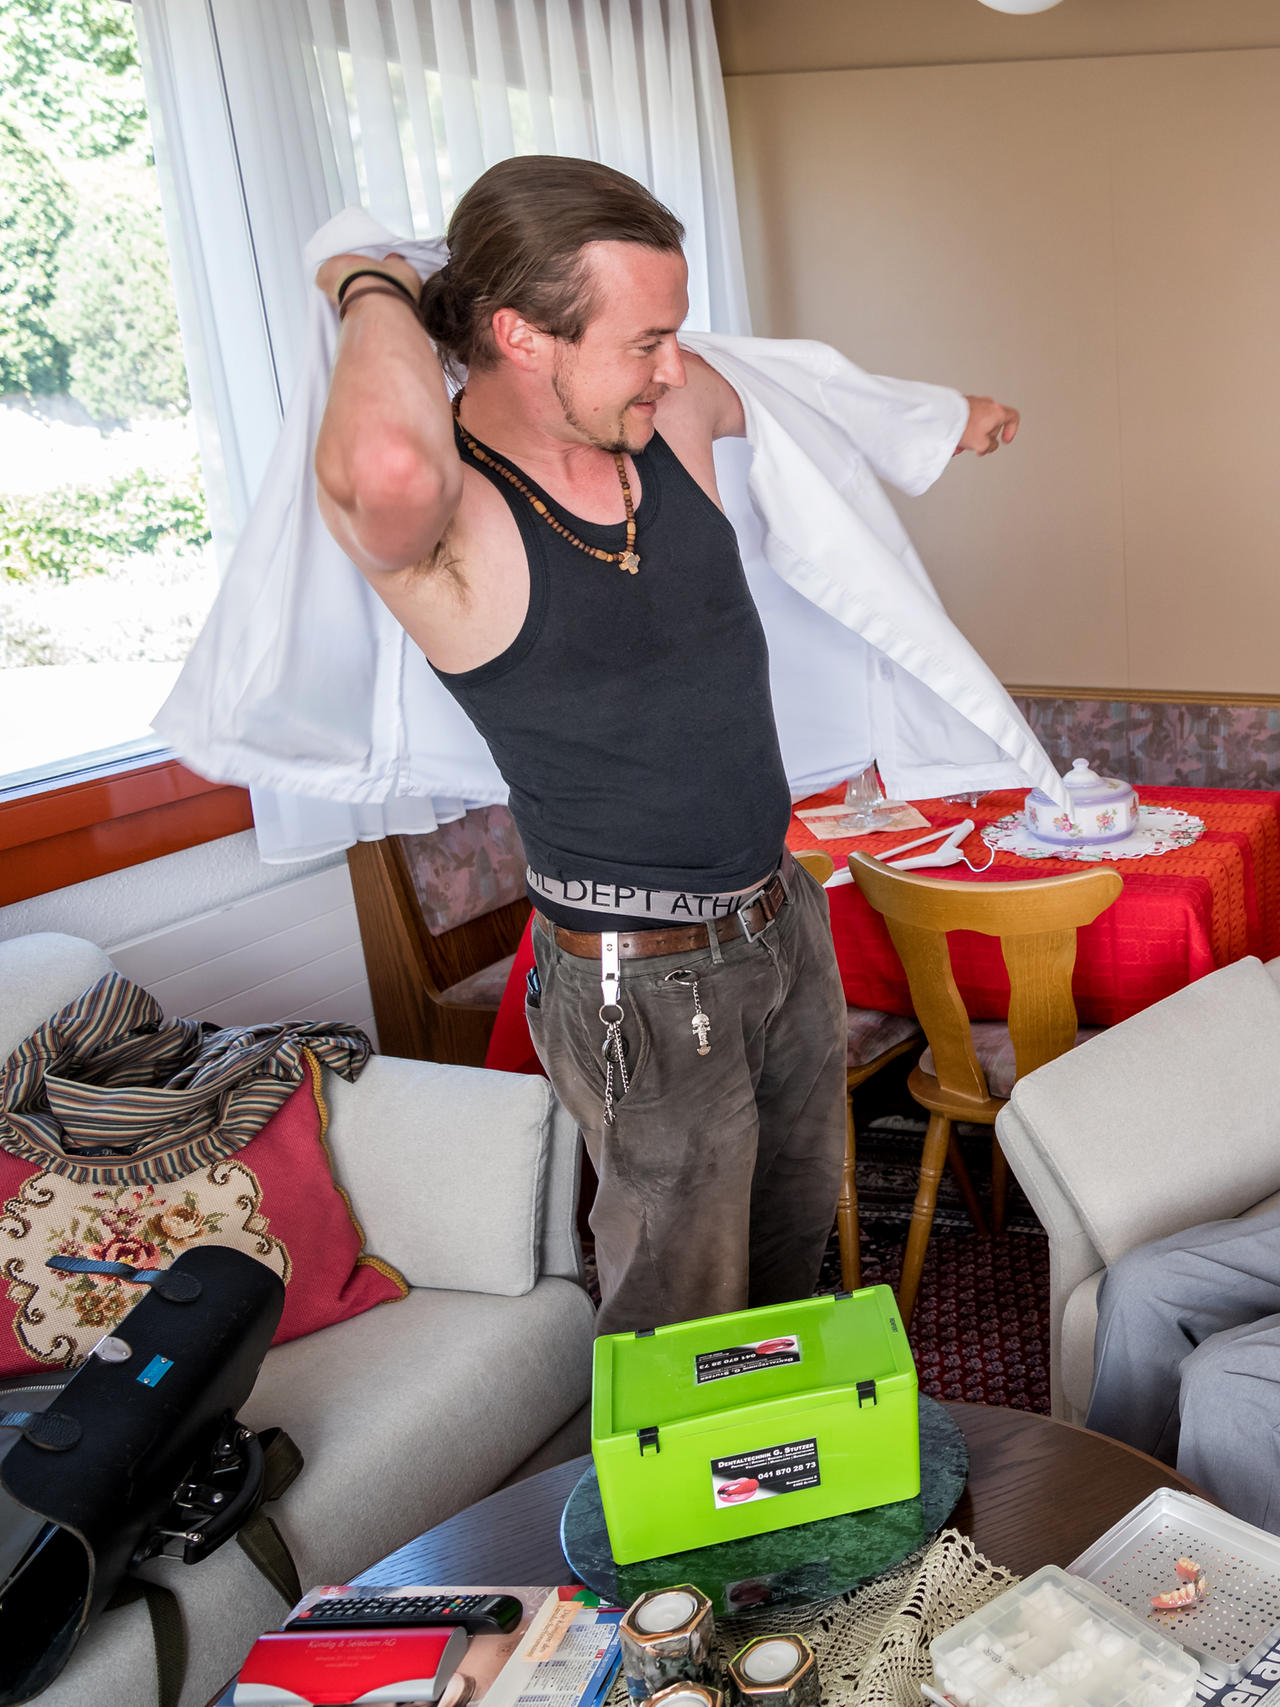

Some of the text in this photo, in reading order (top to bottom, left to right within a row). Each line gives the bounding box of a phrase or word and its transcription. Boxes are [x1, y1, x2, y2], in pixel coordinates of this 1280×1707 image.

[562, 879, 661, 913] DEPT
[784, 1442, 814, 1454] STUTZER
[757, 1471, 774, 1480] 041
[775, 1467, 792, 1477] 870
[805, 1461, 817, 1469] 73
